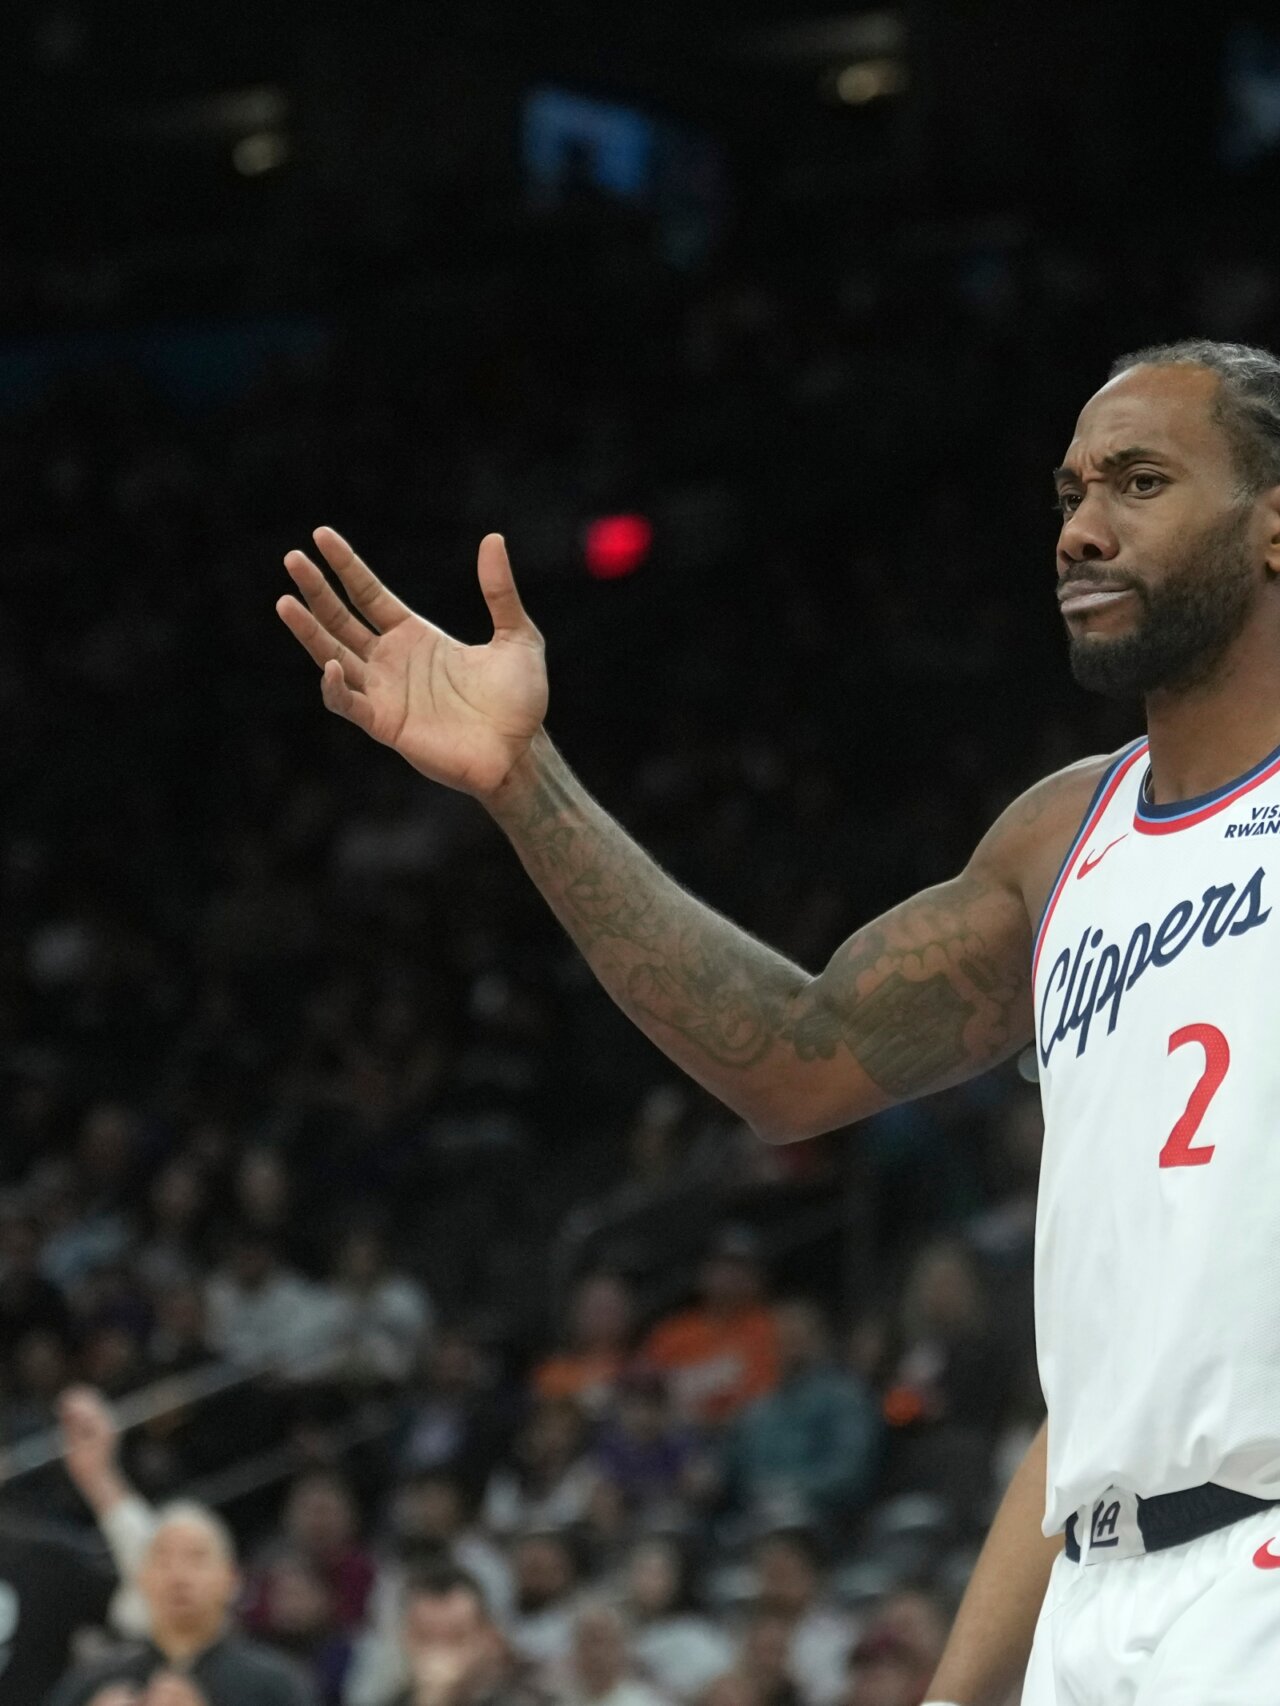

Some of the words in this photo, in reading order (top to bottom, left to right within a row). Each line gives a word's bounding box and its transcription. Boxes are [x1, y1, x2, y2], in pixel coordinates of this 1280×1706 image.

[1040, 866, 1273, 1068] Clippers
[1158, 1022, 1231, 1169] 2
[1089, 1499, 1121, 1549] LA
